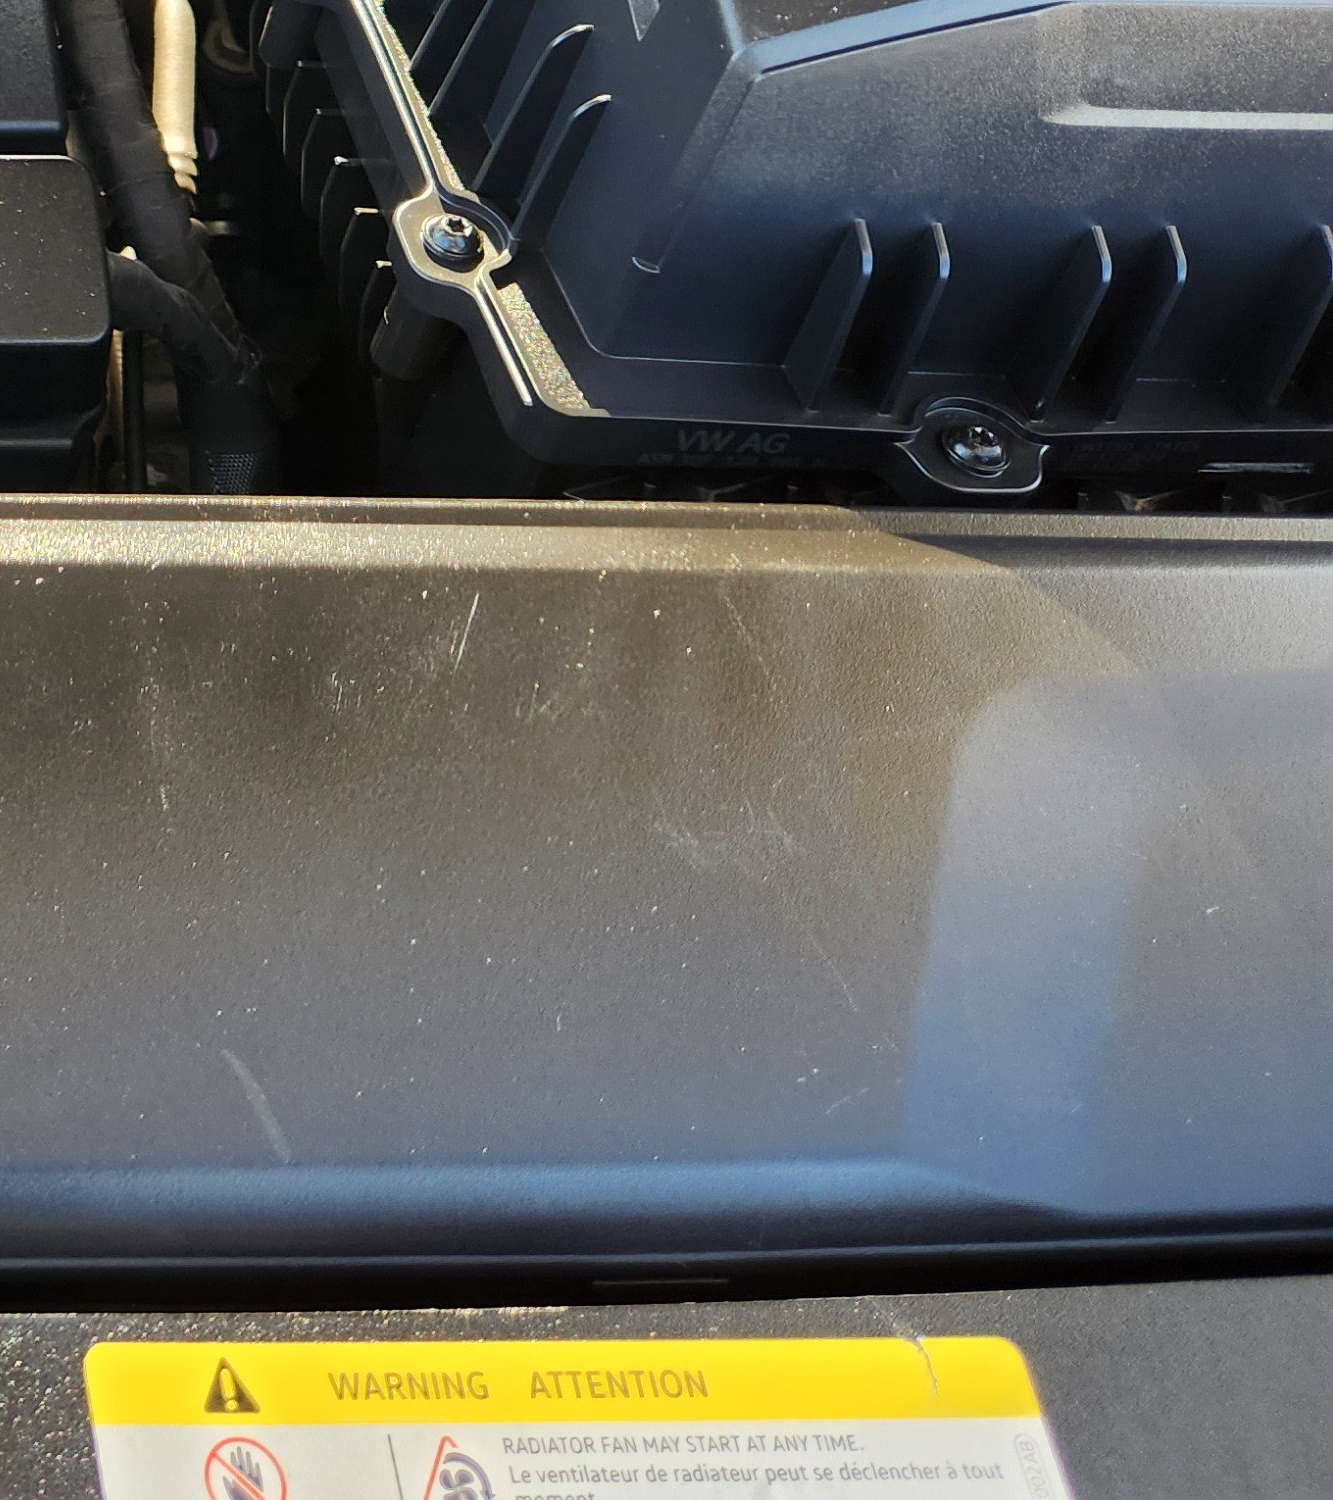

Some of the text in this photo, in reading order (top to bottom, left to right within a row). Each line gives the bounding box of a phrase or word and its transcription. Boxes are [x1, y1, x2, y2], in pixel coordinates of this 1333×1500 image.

[736, 432, 790, 454] AG
[327, 1369, 709, 1401] WARNING ATTENTION
[502, 1435, 865, 1455] RADIATOR FAN MAY START AT ANY TIME.
[509, 1461, 1003, 1488] Le ventilateur de radiateur peut se déclencher à tout
